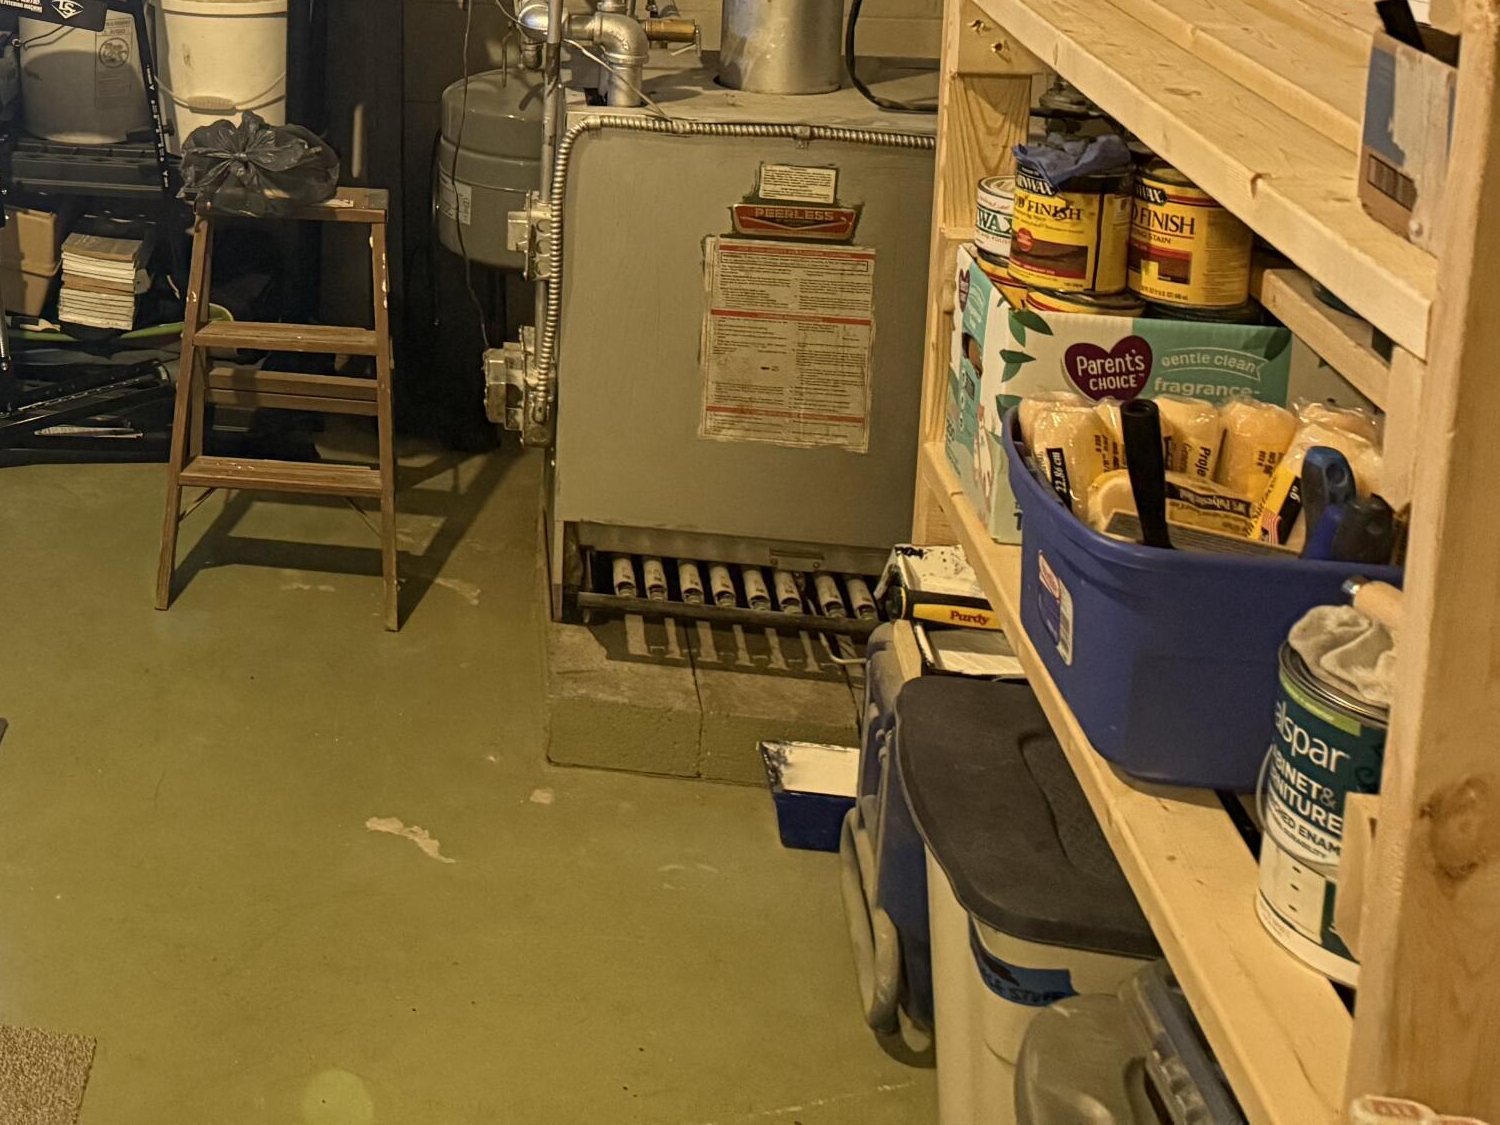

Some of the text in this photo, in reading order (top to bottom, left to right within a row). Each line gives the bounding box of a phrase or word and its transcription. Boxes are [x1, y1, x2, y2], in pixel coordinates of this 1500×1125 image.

[754, 207, 835, 221] PEERLESS
[1028, 199, 1082, 221] FINISH
[1140, 207, 1195, 236] FINISH
[1148, 233, 1172, 244] STAIN
[1076, 348, 1145, 376] Parent's
[1161, 352, 1256, 373] gentle clean
[1089, 375, 1138, 391] CHOICE
[950, 610, 989, 625] Purdy
